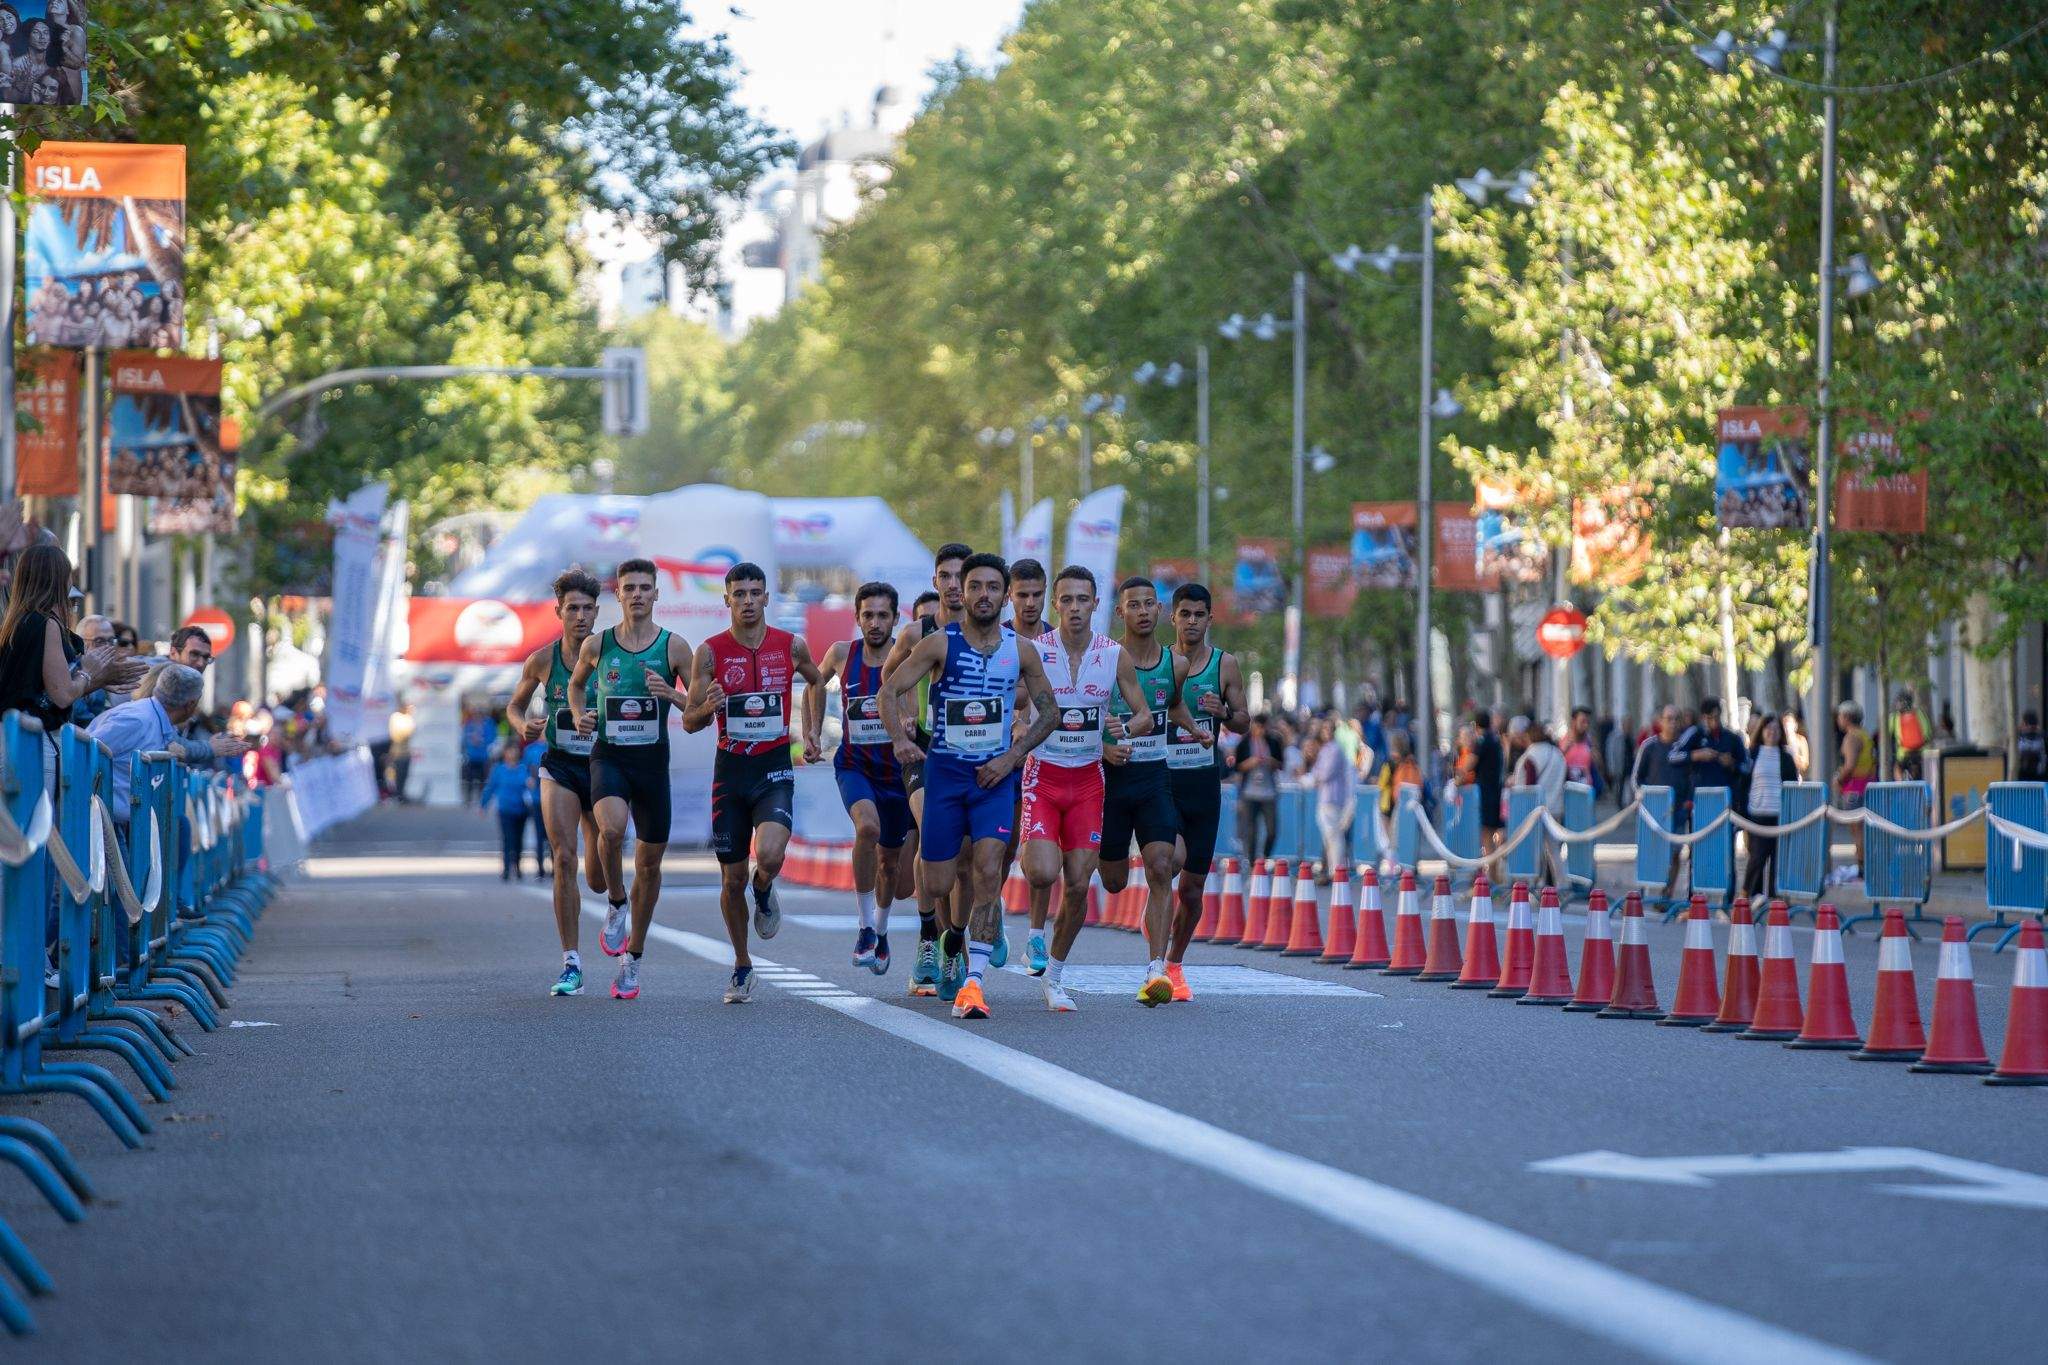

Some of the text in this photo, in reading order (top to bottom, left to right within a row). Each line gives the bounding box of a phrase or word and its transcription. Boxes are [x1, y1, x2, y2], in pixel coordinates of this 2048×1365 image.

[36, 165, 102, 192] ISLA
[116, 367, 165, 389] ISLA
[1721, 419, 1762, 437] ISLA
[1084, 684, 1110, 698] Rico
[645, 700, 653, 712] 3
[768, 694, 777, 707] 6
[990, 700, 997, 713] 1
[1086, 708, 1097, 721] 12
[1157, 713, 1164, 726] 5
[744, 721, 766, 729] NACHO
[1059, 735, 1085, 743] VILCHES
